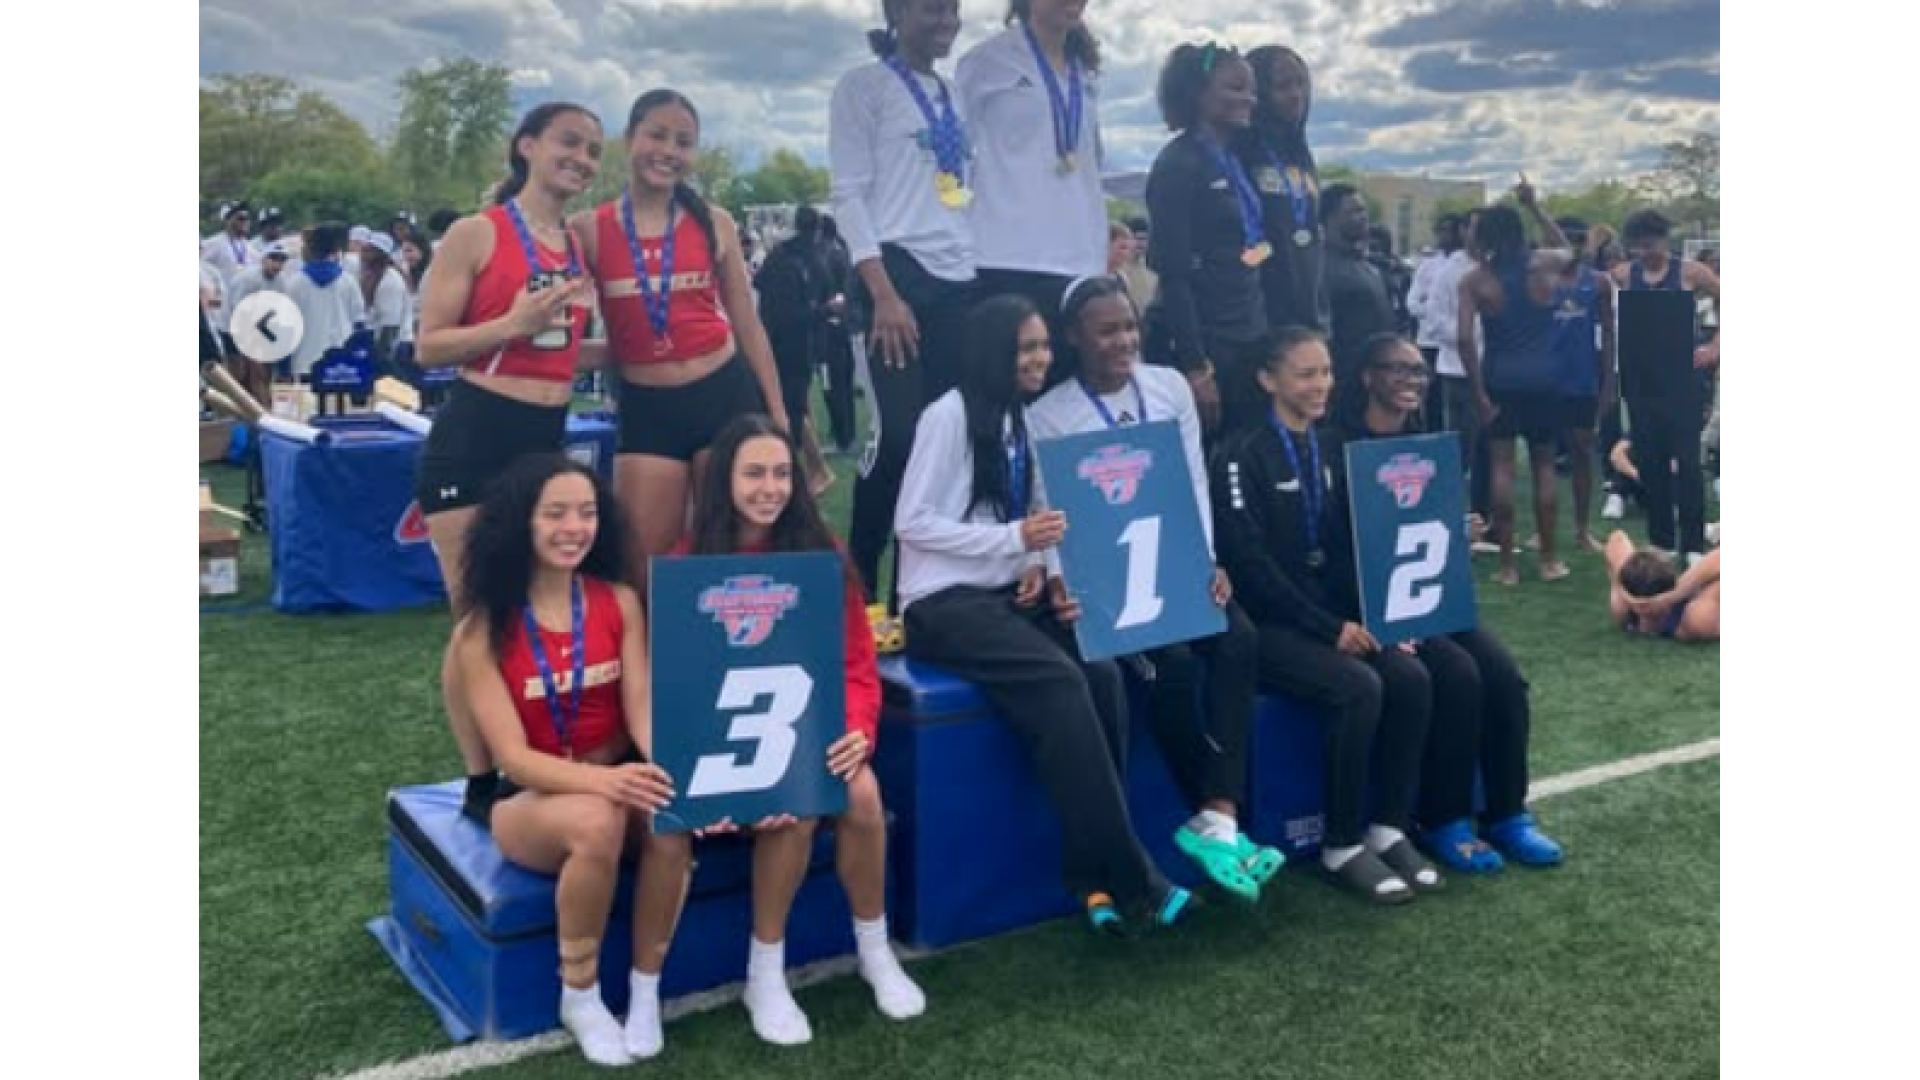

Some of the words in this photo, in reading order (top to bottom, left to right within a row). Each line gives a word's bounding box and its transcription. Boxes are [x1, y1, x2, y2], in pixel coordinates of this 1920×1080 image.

[1115, 514, 1164, 631] 1
[1384, 519, 1450, 623] 2
[686, 664, 814, 798] 3
